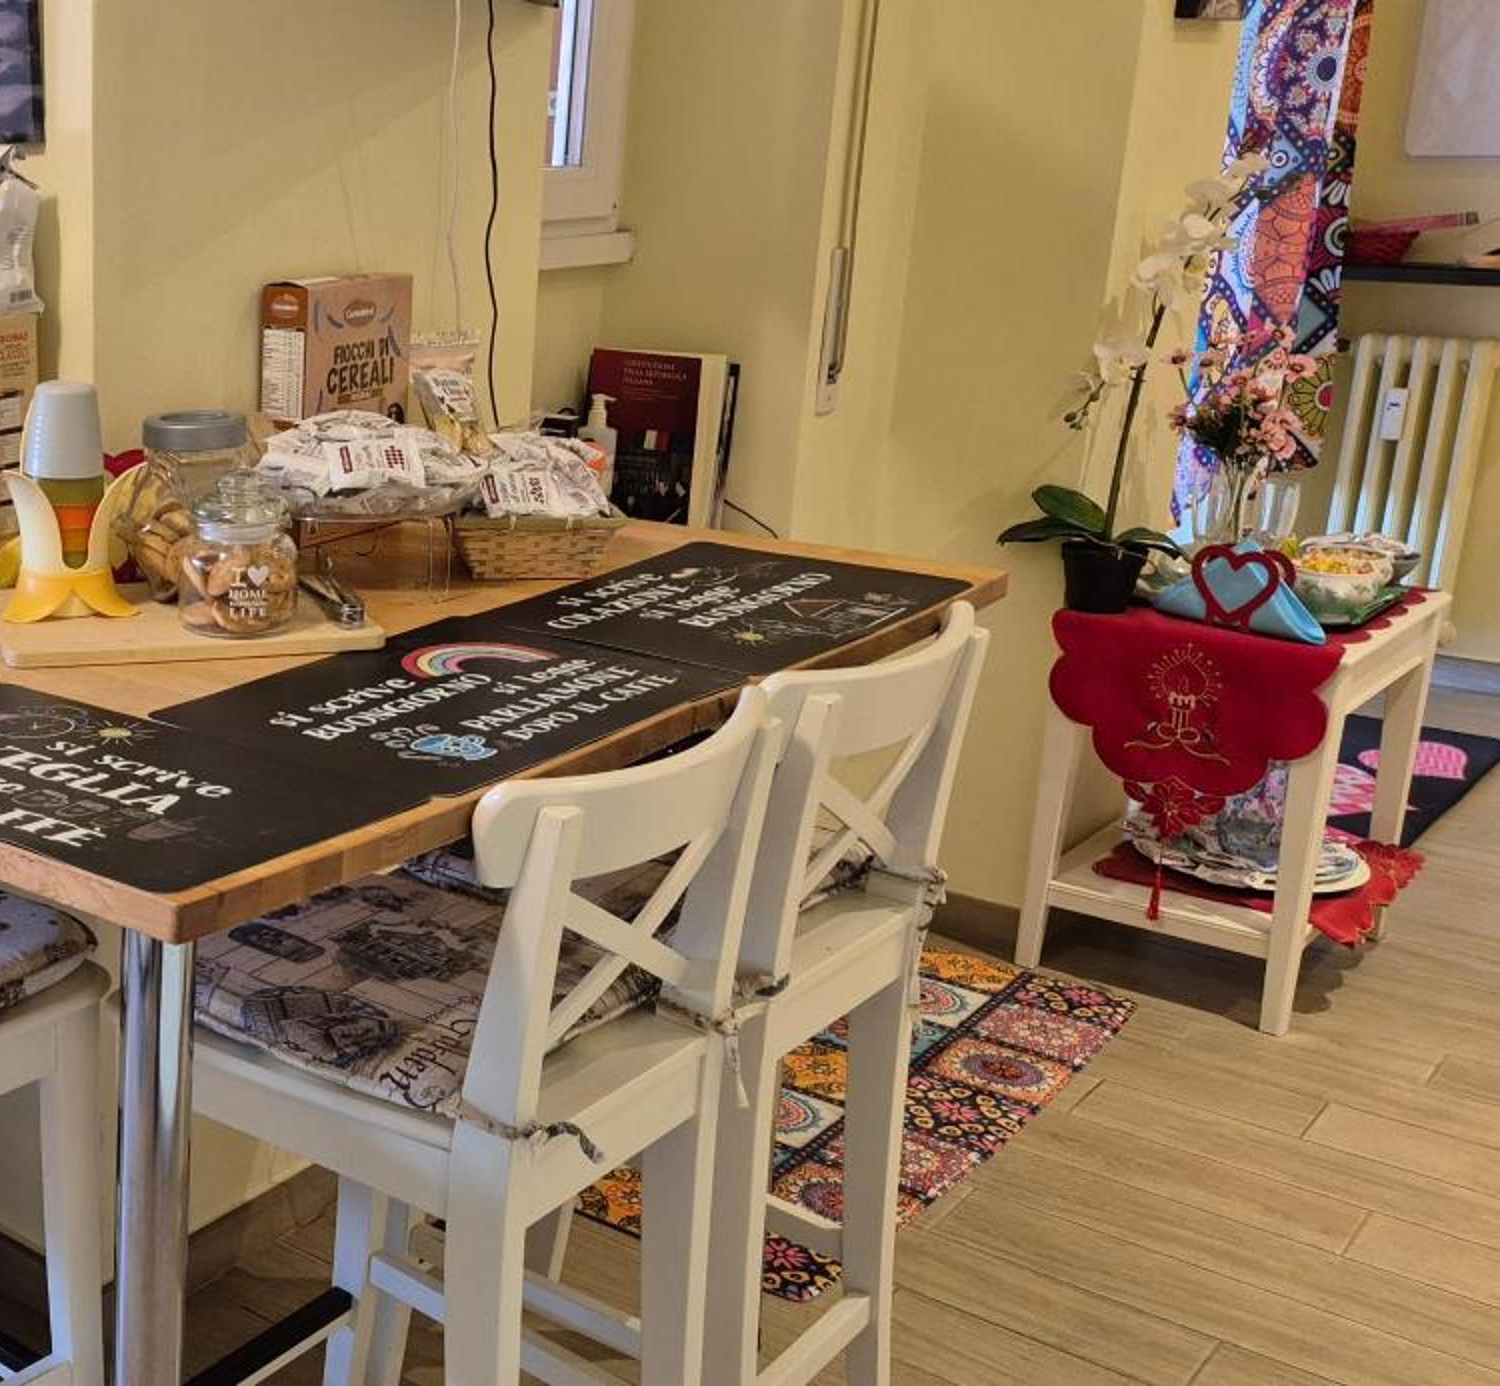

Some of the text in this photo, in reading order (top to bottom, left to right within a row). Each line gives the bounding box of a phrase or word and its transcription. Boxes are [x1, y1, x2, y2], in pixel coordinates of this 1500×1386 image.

[327, 357, 394, 395] CEREALI
[333, 341, 375, 365] FIOCCHI
[230, 567, 246, 587] I
[230, 607, 267, 617] LIFE
[270, 678, 416, 727] si scrive
[302, 673, 492, 741] BUONGIORNO
[460, 664, 639, 731] PARLIAMONE
[502, 710, 580, 741] DOPO
[575, 694, 608, 713] IL
[46, 740, 232, 798] si scrive
